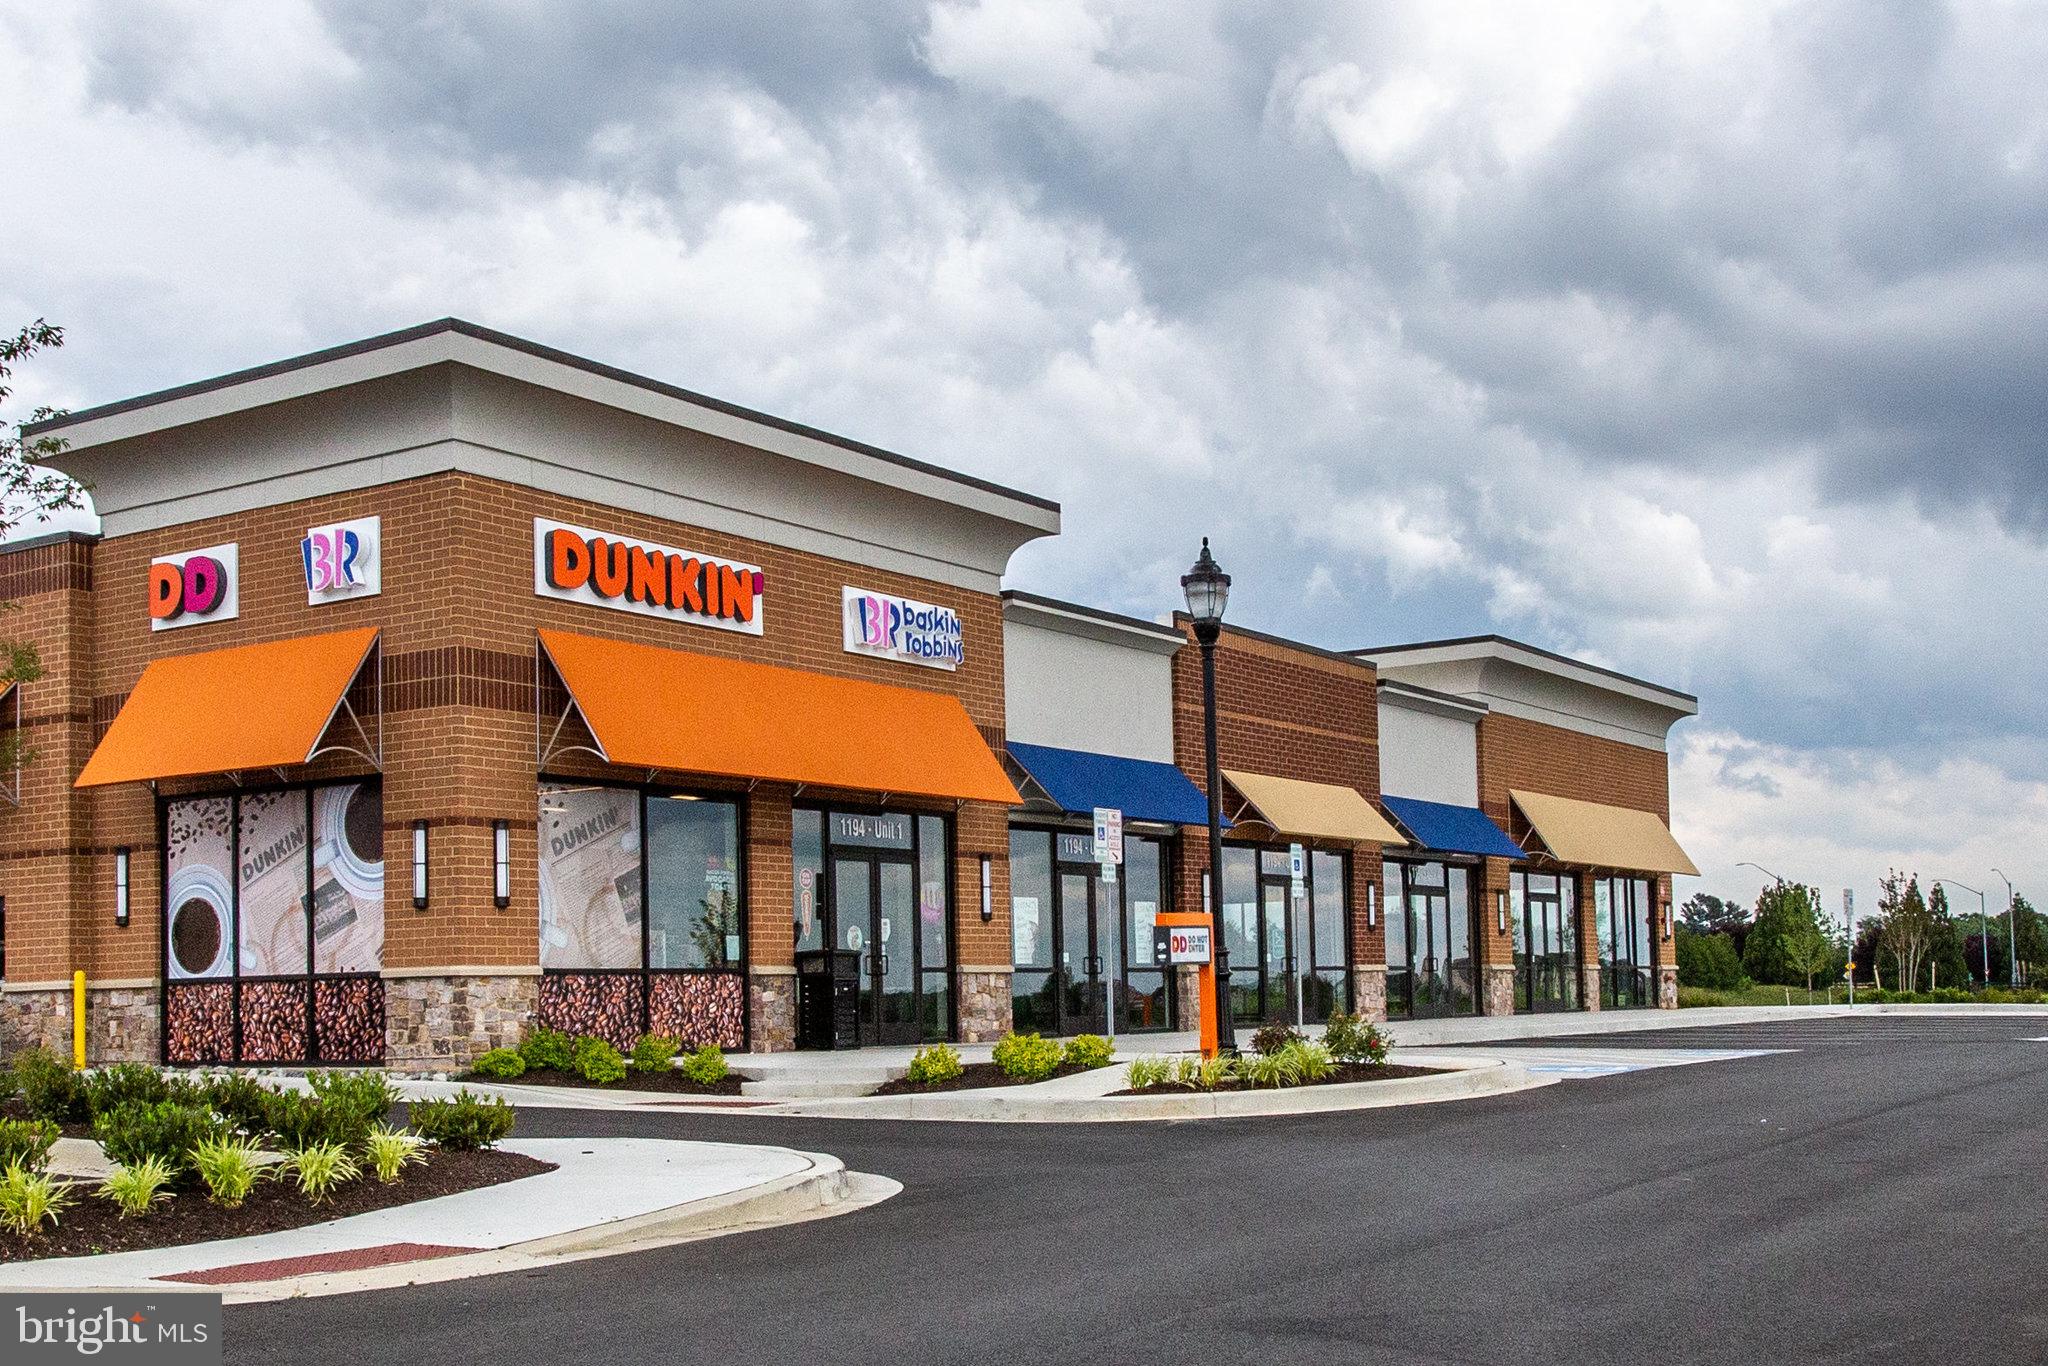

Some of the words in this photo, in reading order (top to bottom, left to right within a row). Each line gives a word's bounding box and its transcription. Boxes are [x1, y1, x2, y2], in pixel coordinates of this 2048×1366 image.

[301, 528, 366, 592] BR
[548, 528, 764, 624] DUNKIN'
[149, 556, 224, 619] DD
[857, 596, 900, 649] BR
[841, 818, 865, 837] 1194
[875, 820, 894, 839] Unit
[897, 822, 902, 839] 1
[1064, 838, 1083, 854] 1194
[1172, 935, 1187, 953] DD
[1188, 935, 1196, 943] DO
[1197, 935, 1208, 943] NOT
[1188, 944, 1205, 953] ENTER
